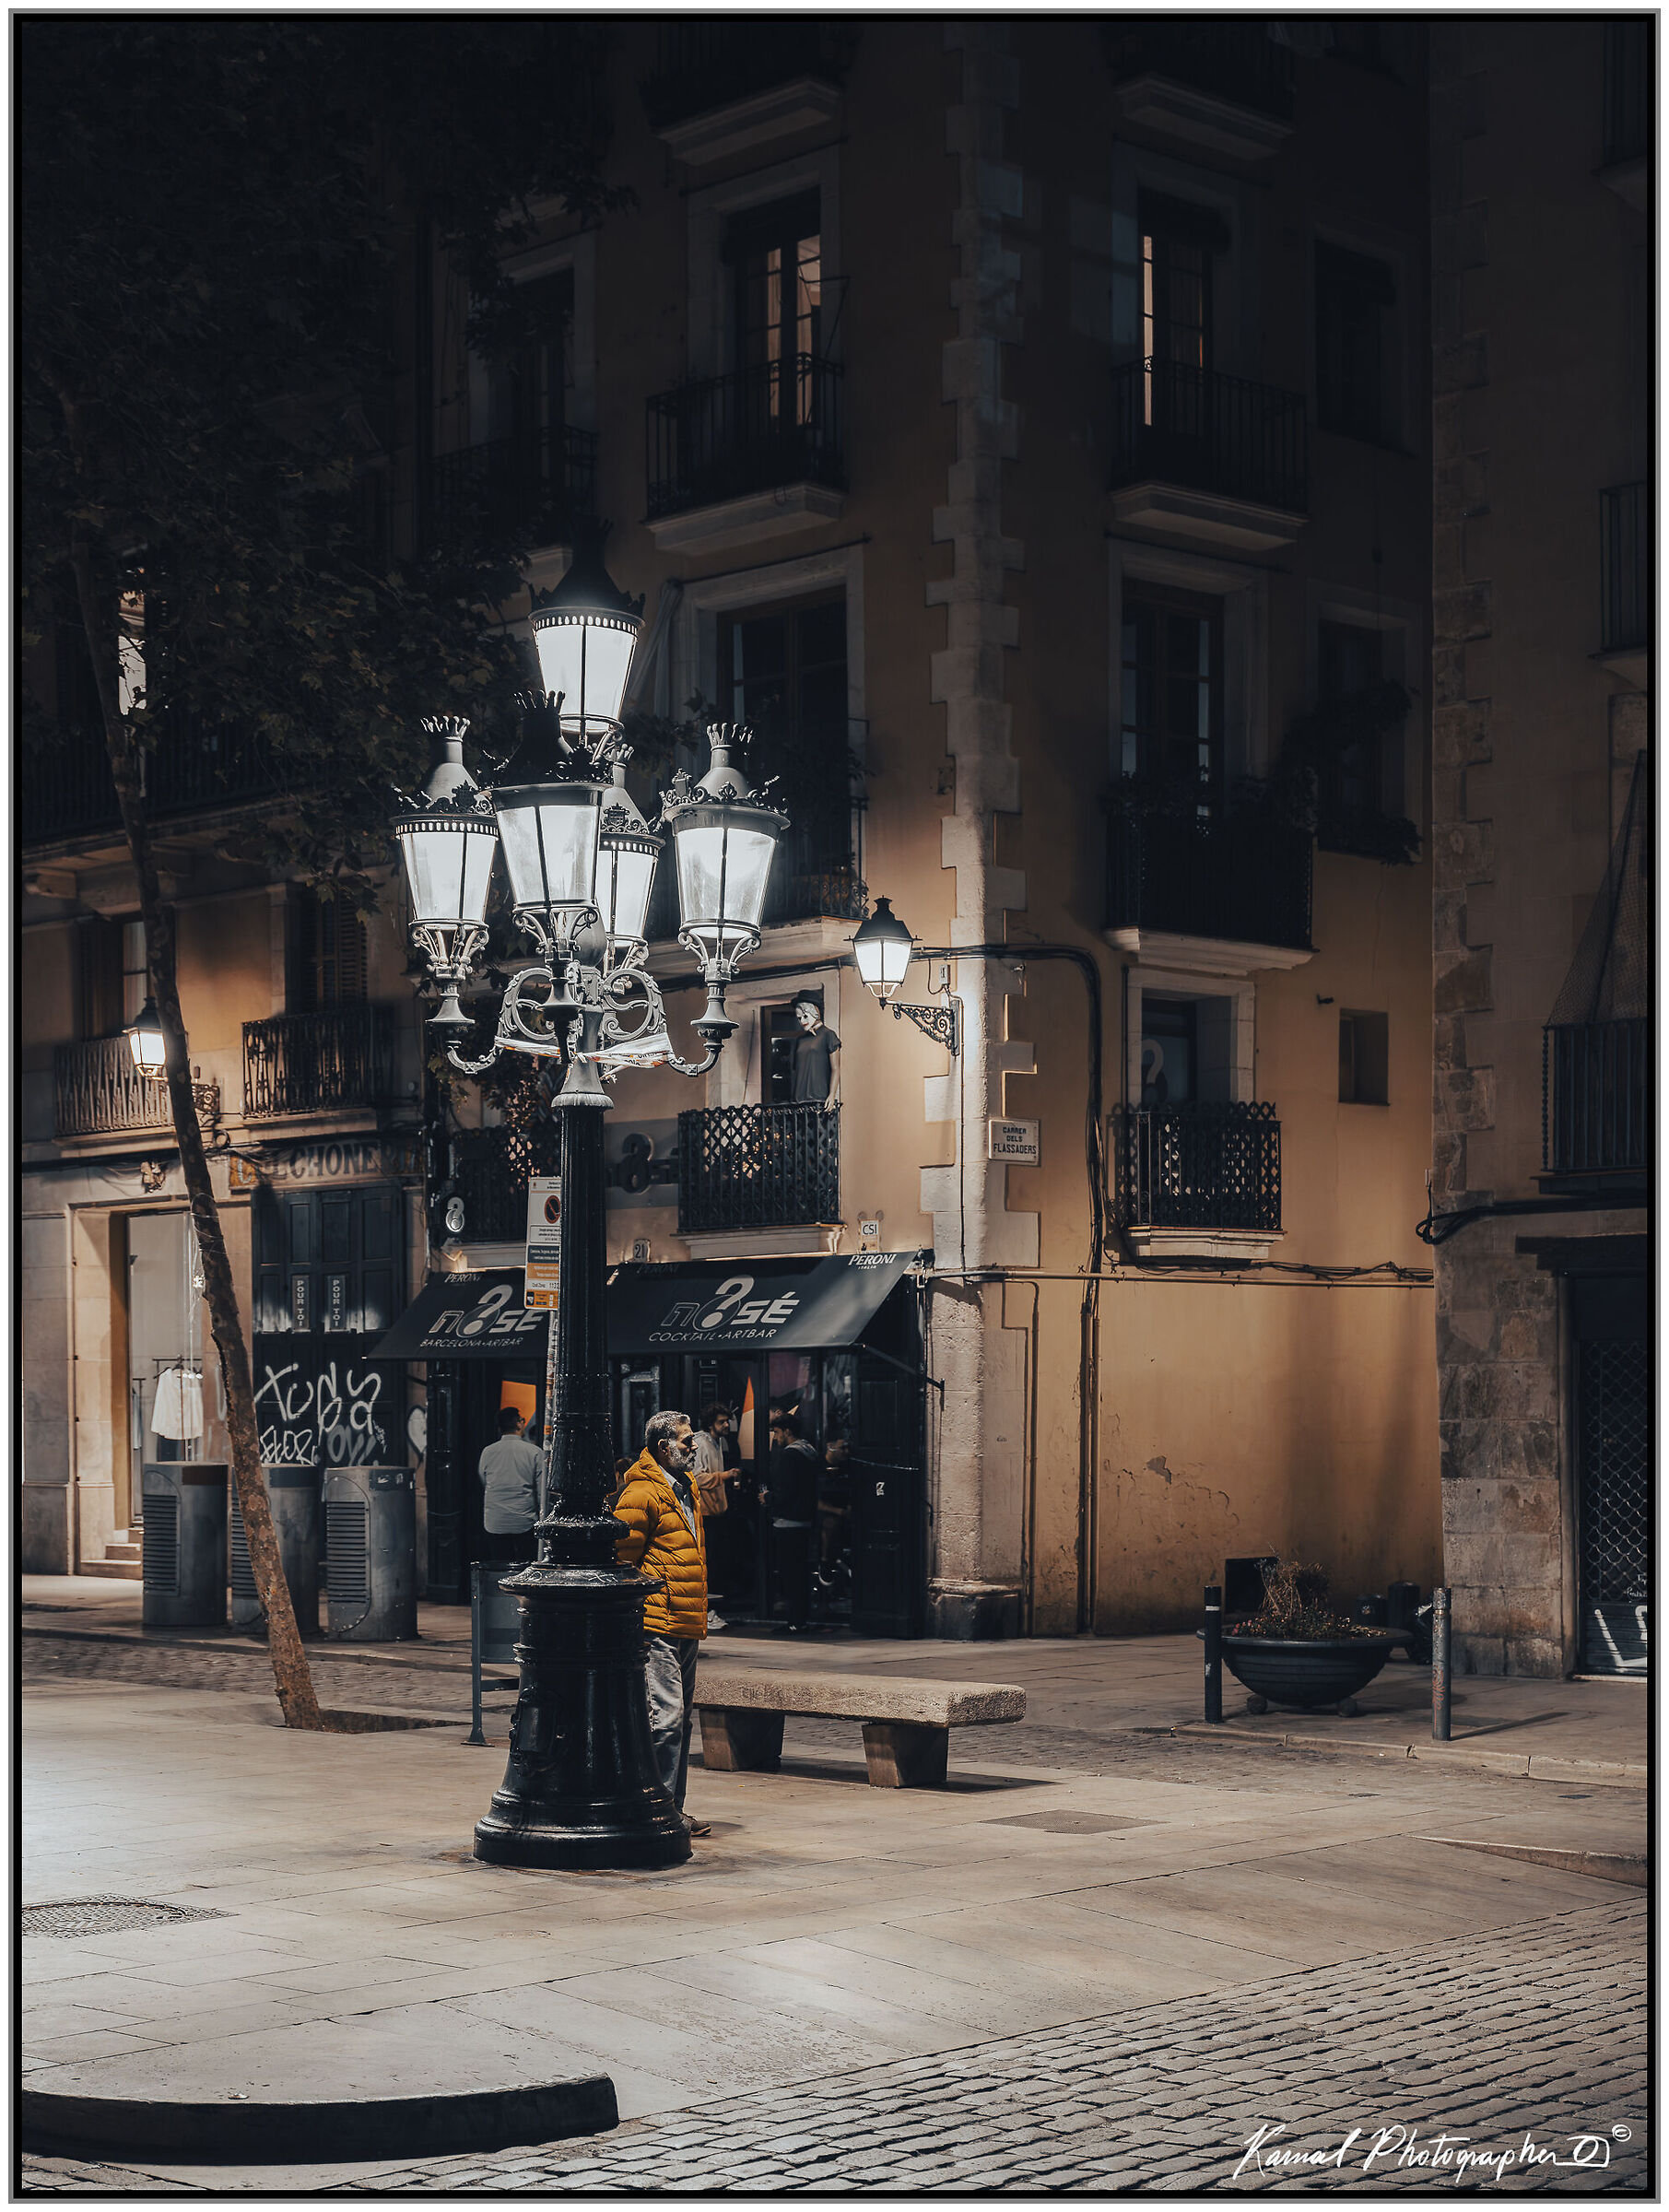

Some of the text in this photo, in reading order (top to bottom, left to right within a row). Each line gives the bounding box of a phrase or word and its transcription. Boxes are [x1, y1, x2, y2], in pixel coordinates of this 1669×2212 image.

[1002, 1126, 1027, 1135] CARRER
[1006, 1135, 1023, 1143] DELS
[993, 1143, 1037, 1155] FLASSADERS
[862, 1224, 877, 1235] CSI
[634, 1243, 645, 1259] 21
[848, 1253, 897, 1266] PERONI
[297, 1279, 305, 1305] POUR
